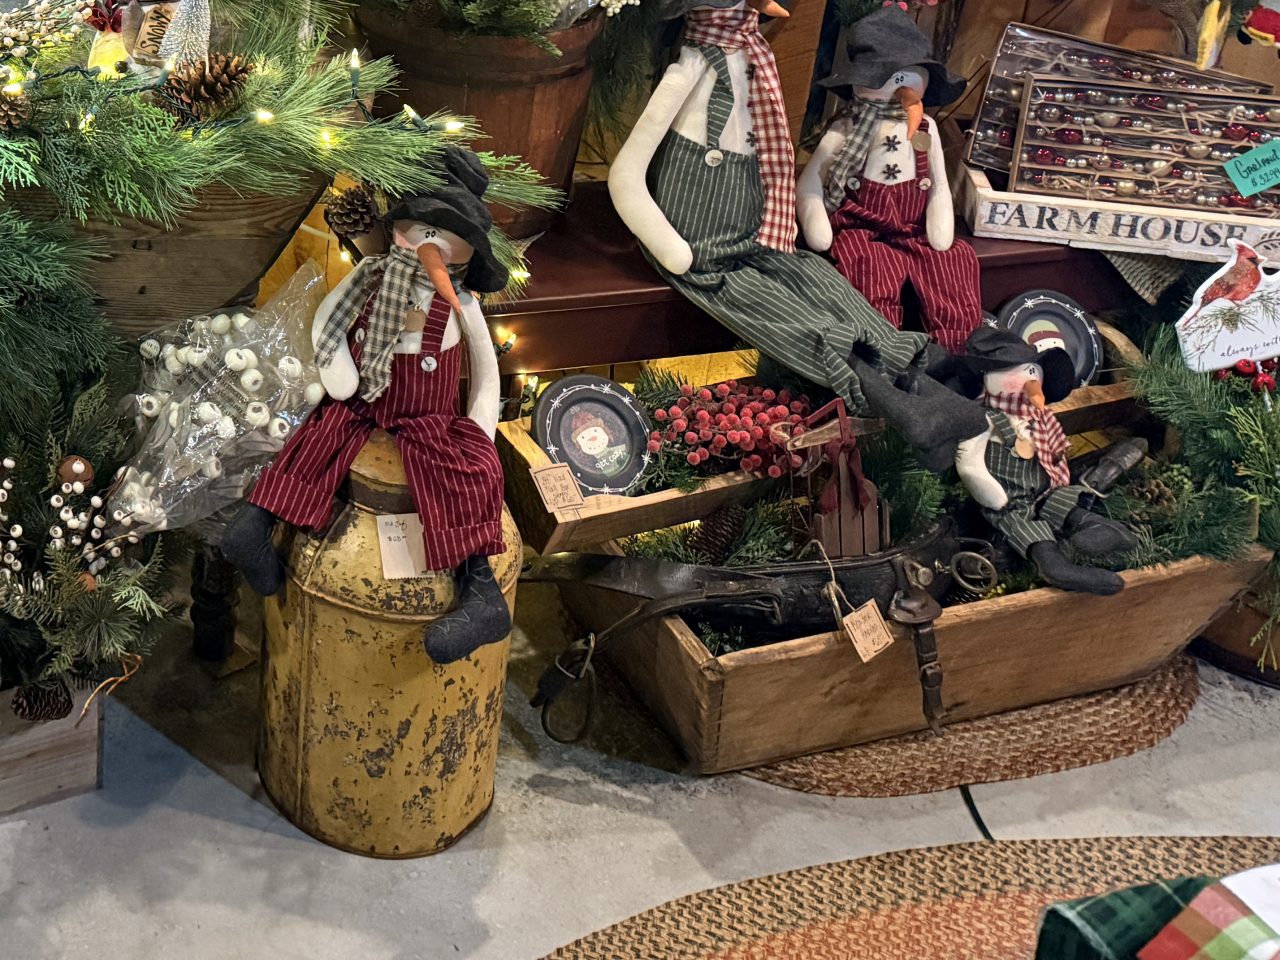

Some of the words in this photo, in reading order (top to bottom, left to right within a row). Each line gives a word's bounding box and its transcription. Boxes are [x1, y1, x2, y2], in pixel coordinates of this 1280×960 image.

[984, 201, 1102, 235] FARM
[1108, 212, 1248, 249] HOUSE
[1220, 344, 1260, 358] always
[1263, 335, 1280, 348] wit
